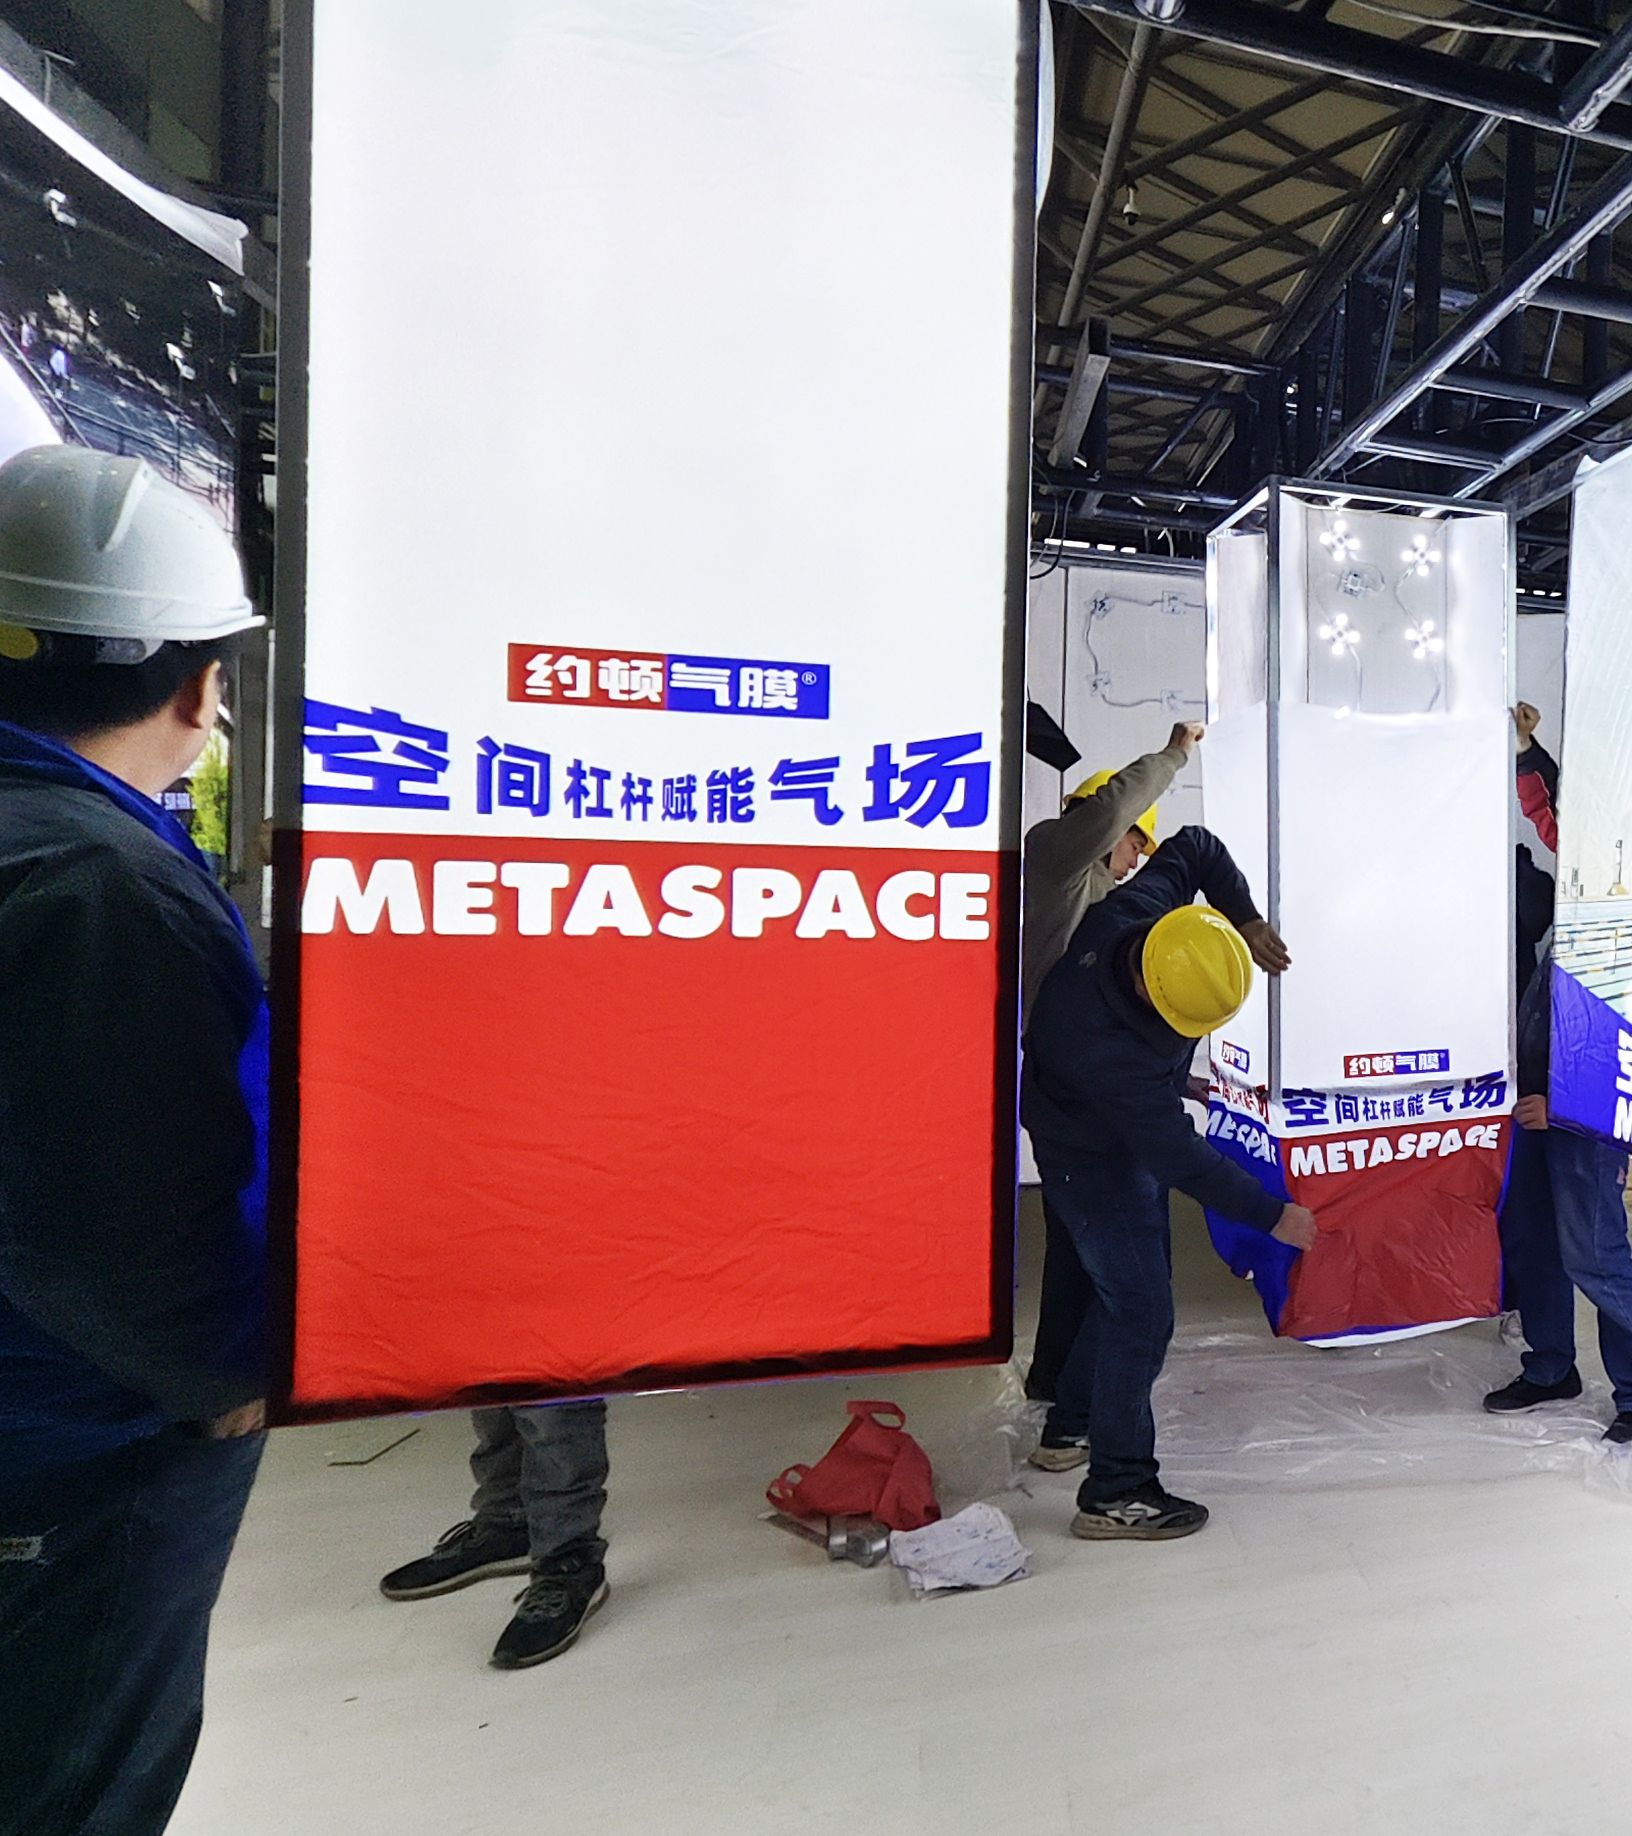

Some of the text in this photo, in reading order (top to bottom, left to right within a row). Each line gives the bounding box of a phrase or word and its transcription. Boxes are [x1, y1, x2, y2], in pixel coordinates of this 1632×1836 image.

[303, 697, 992, 829] 空间杠杆赋能气场
[301, 857, 991, 941] METASPACE
[1281, 1070, 1507, 1127] 空间杠杆赋能气场
[1290, 1123, 1500, 1178] METASPACE
